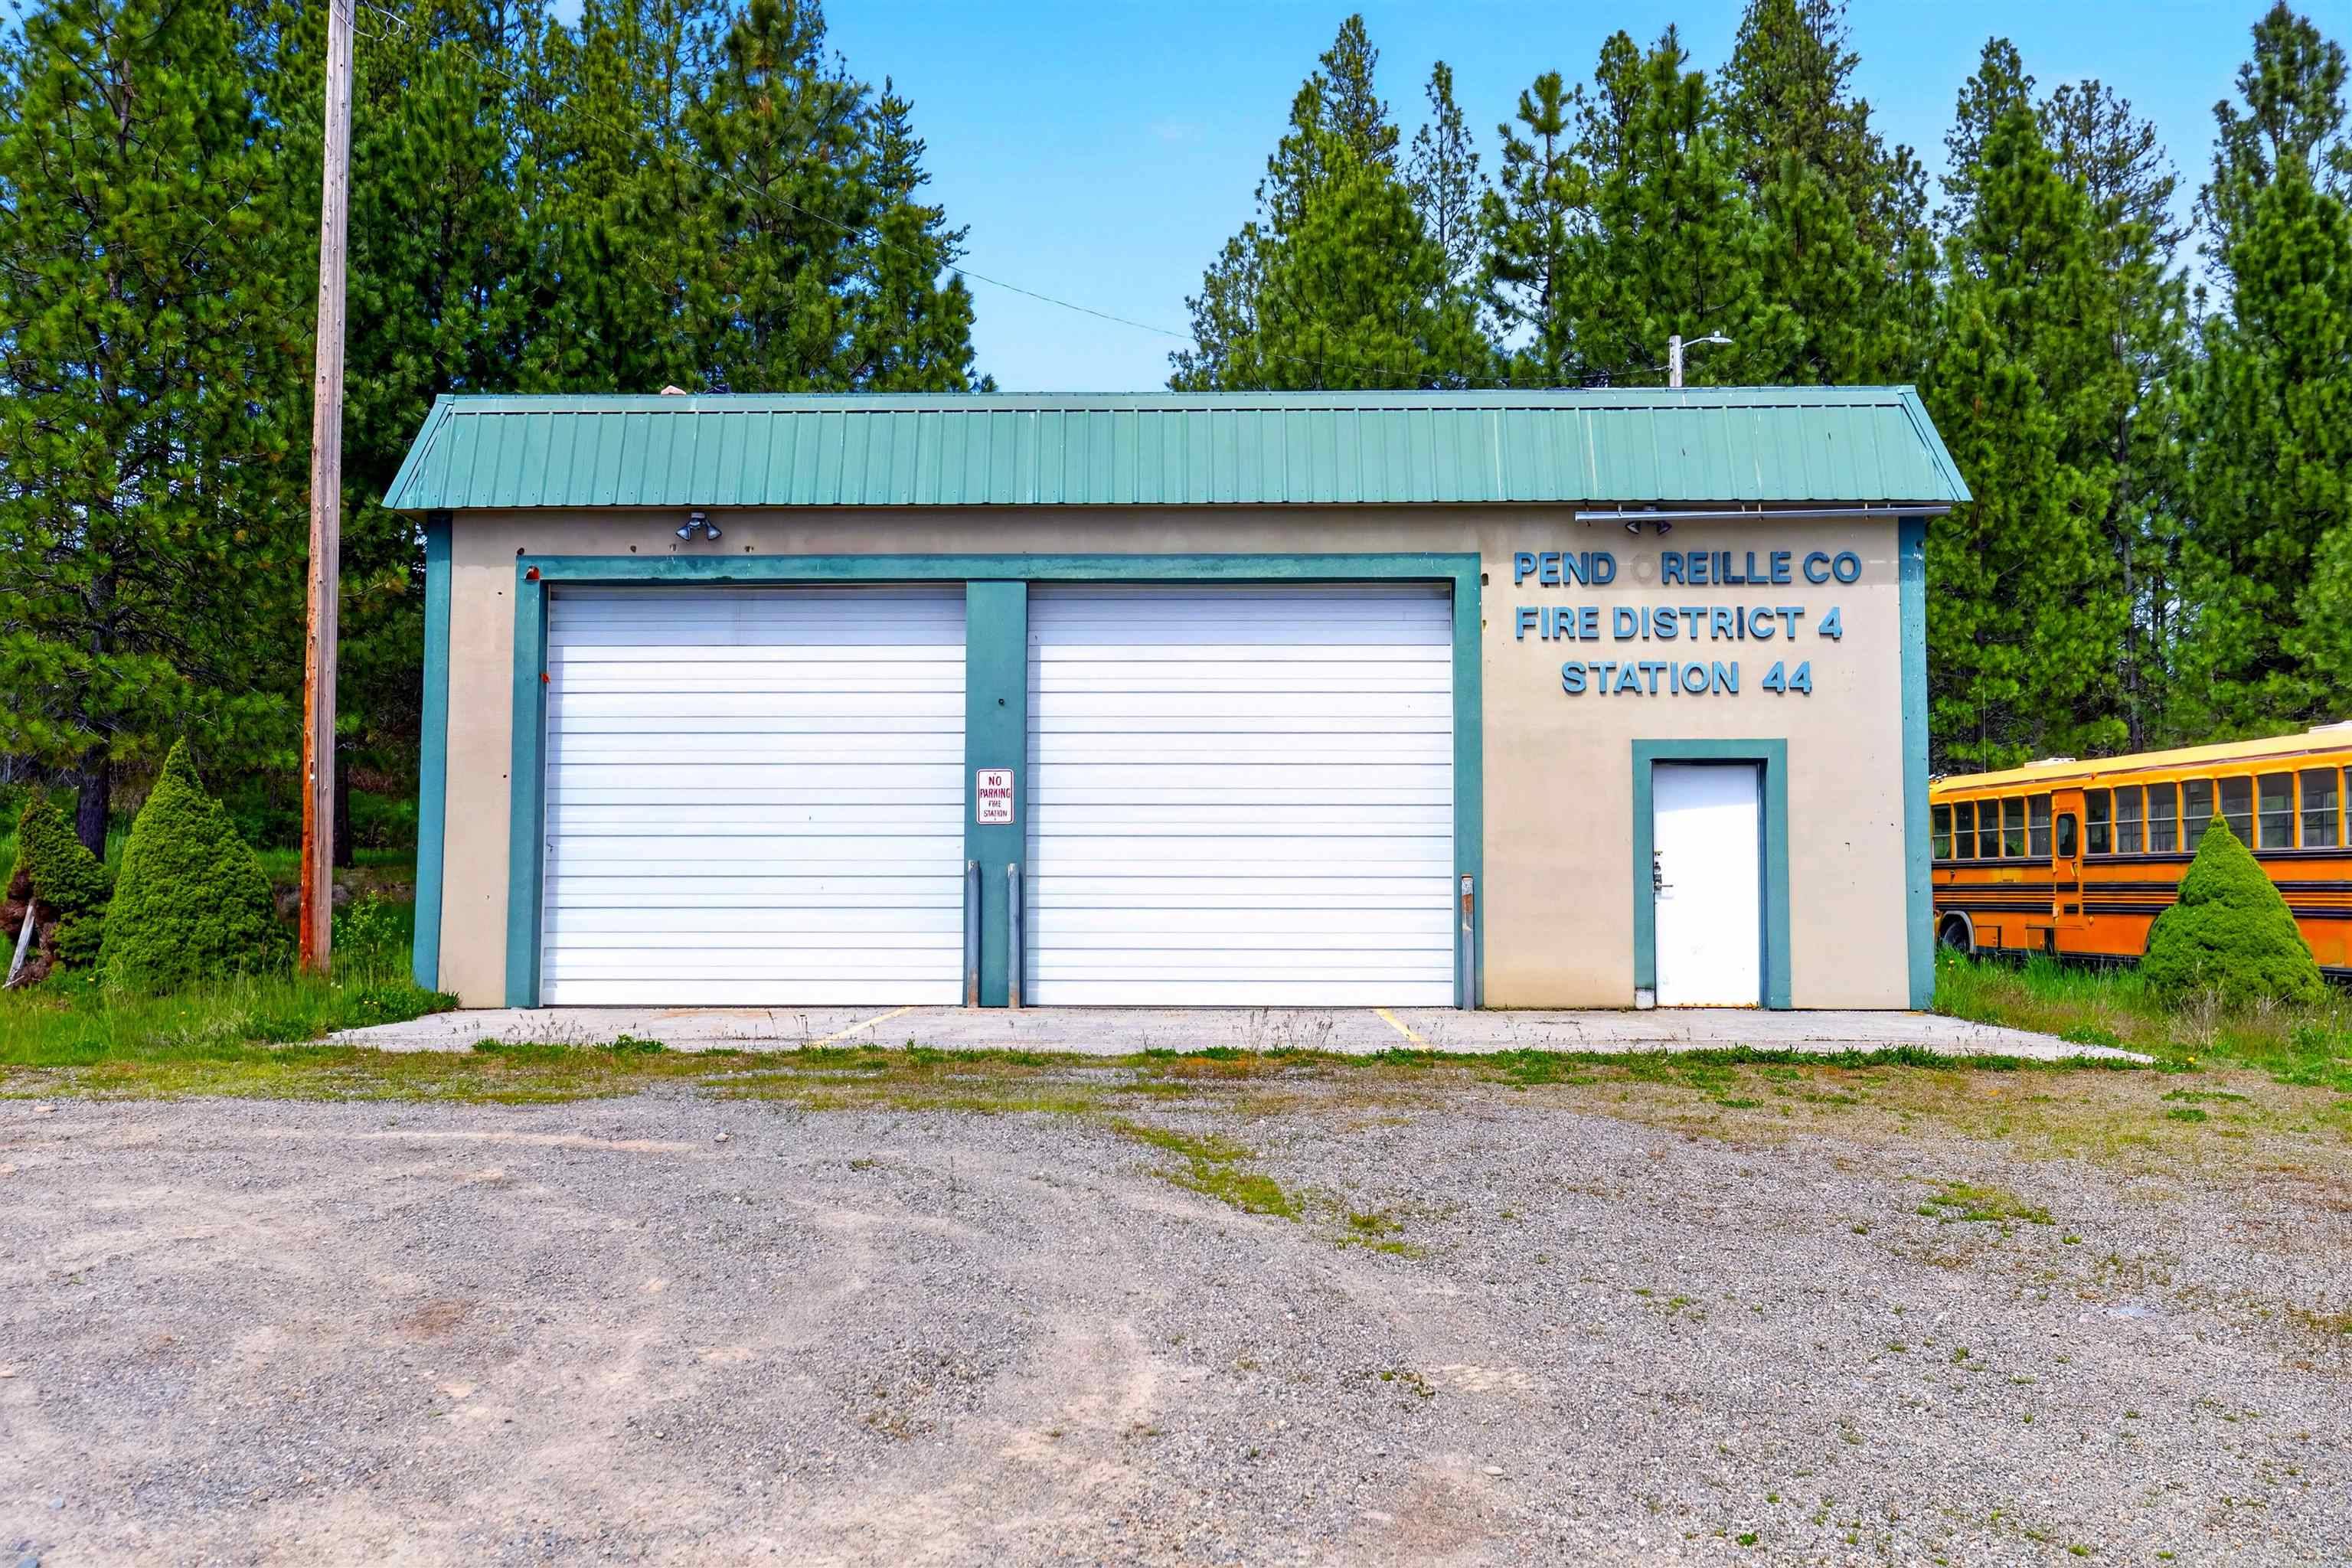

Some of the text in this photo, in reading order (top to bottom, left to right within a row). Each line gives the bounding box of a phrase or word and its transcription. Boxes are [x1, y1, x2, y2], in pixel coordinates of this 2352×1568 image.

[1514, 551, 1616, 584] PEND
[1803, 551, 1862, 583] CO
[1516, 606, 1843, 641] FIRE DISTRICT 4
[1561, 661, 1811, 694] STATION 44
[980, 788, 1011, 799] PARKING
[988, 776, 1001, 786] NO
